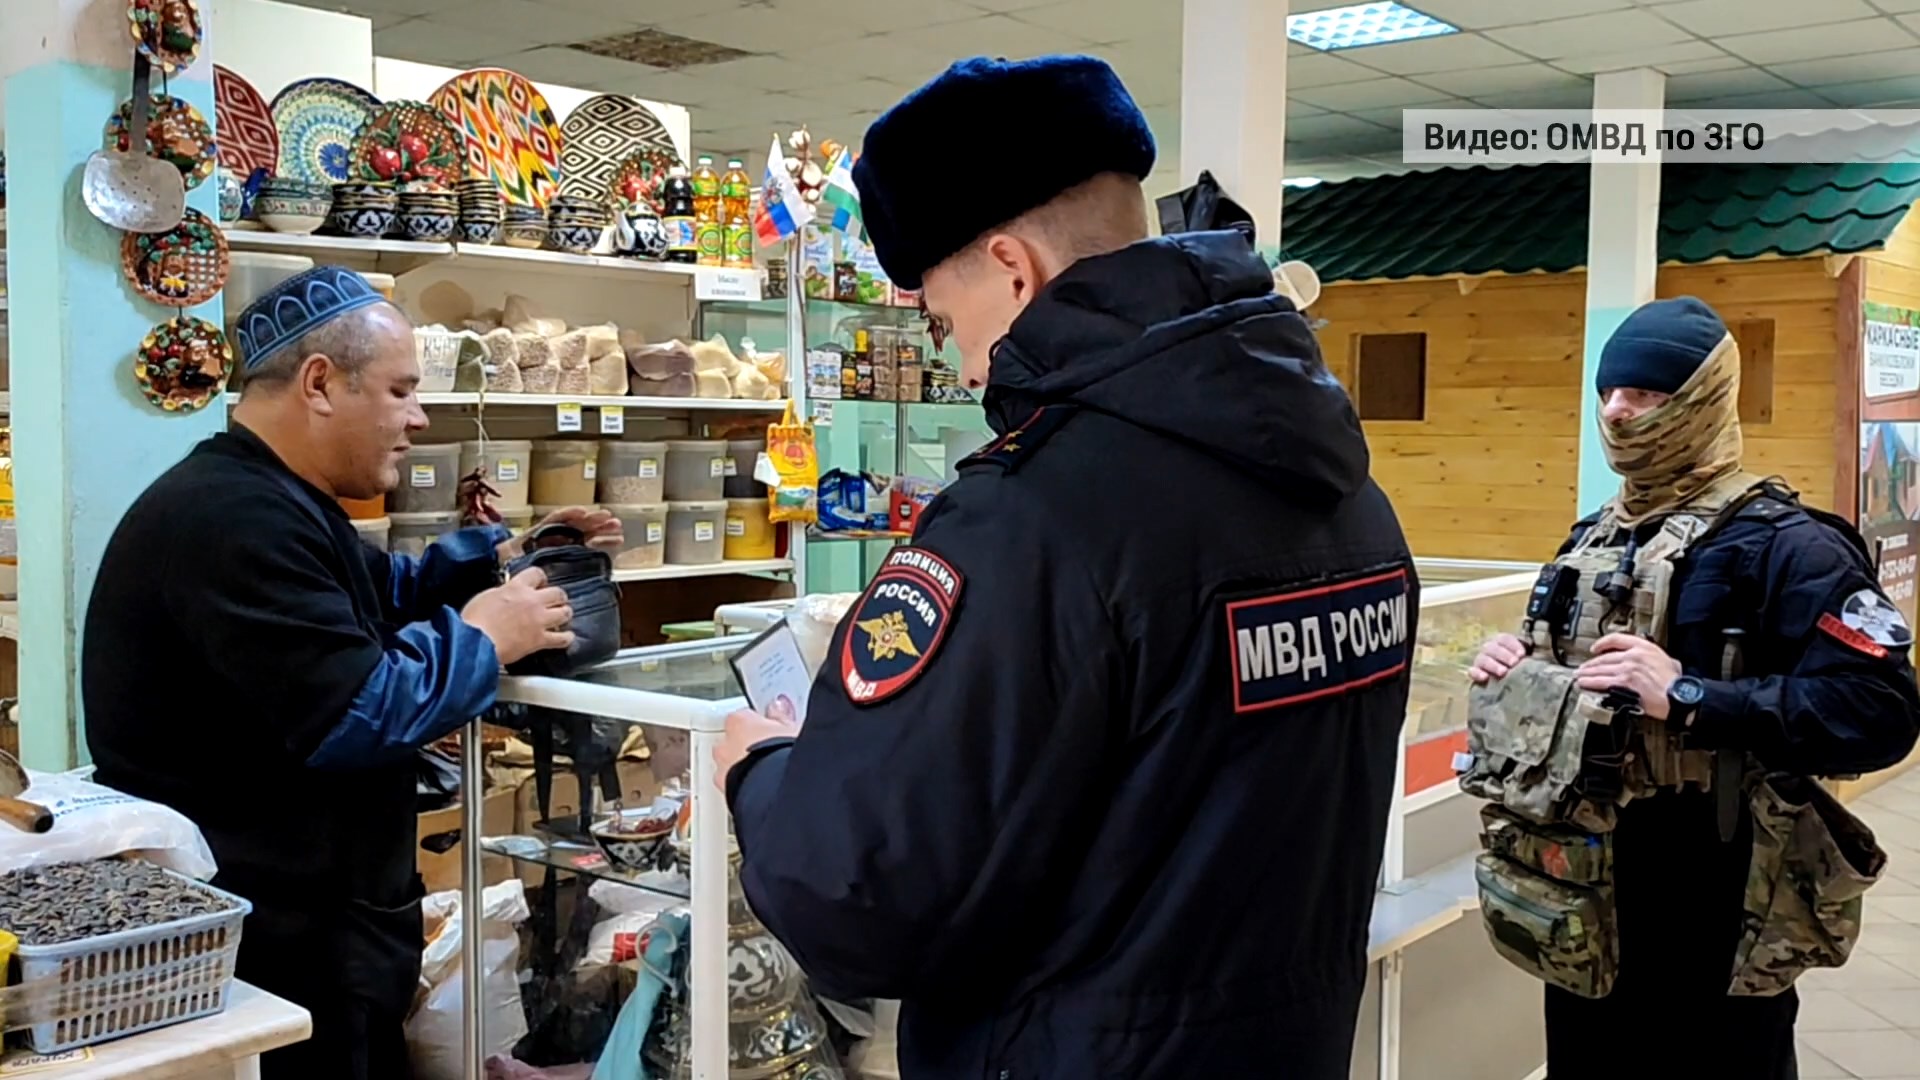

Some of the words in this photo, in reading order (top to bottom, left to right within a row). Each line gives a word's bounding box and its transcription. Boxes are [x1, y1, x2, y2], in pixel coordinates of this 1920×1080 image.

[1867, 325, 1920, 350] КАРКАСНЫЕ
[889, 550, 956, 595] ПОЛИЦИЯ
[873, 582, 938, 628] РОССИЯ
[1236, 615, 1328, 683] МВД
[846, 668, 878, 698] МВД
